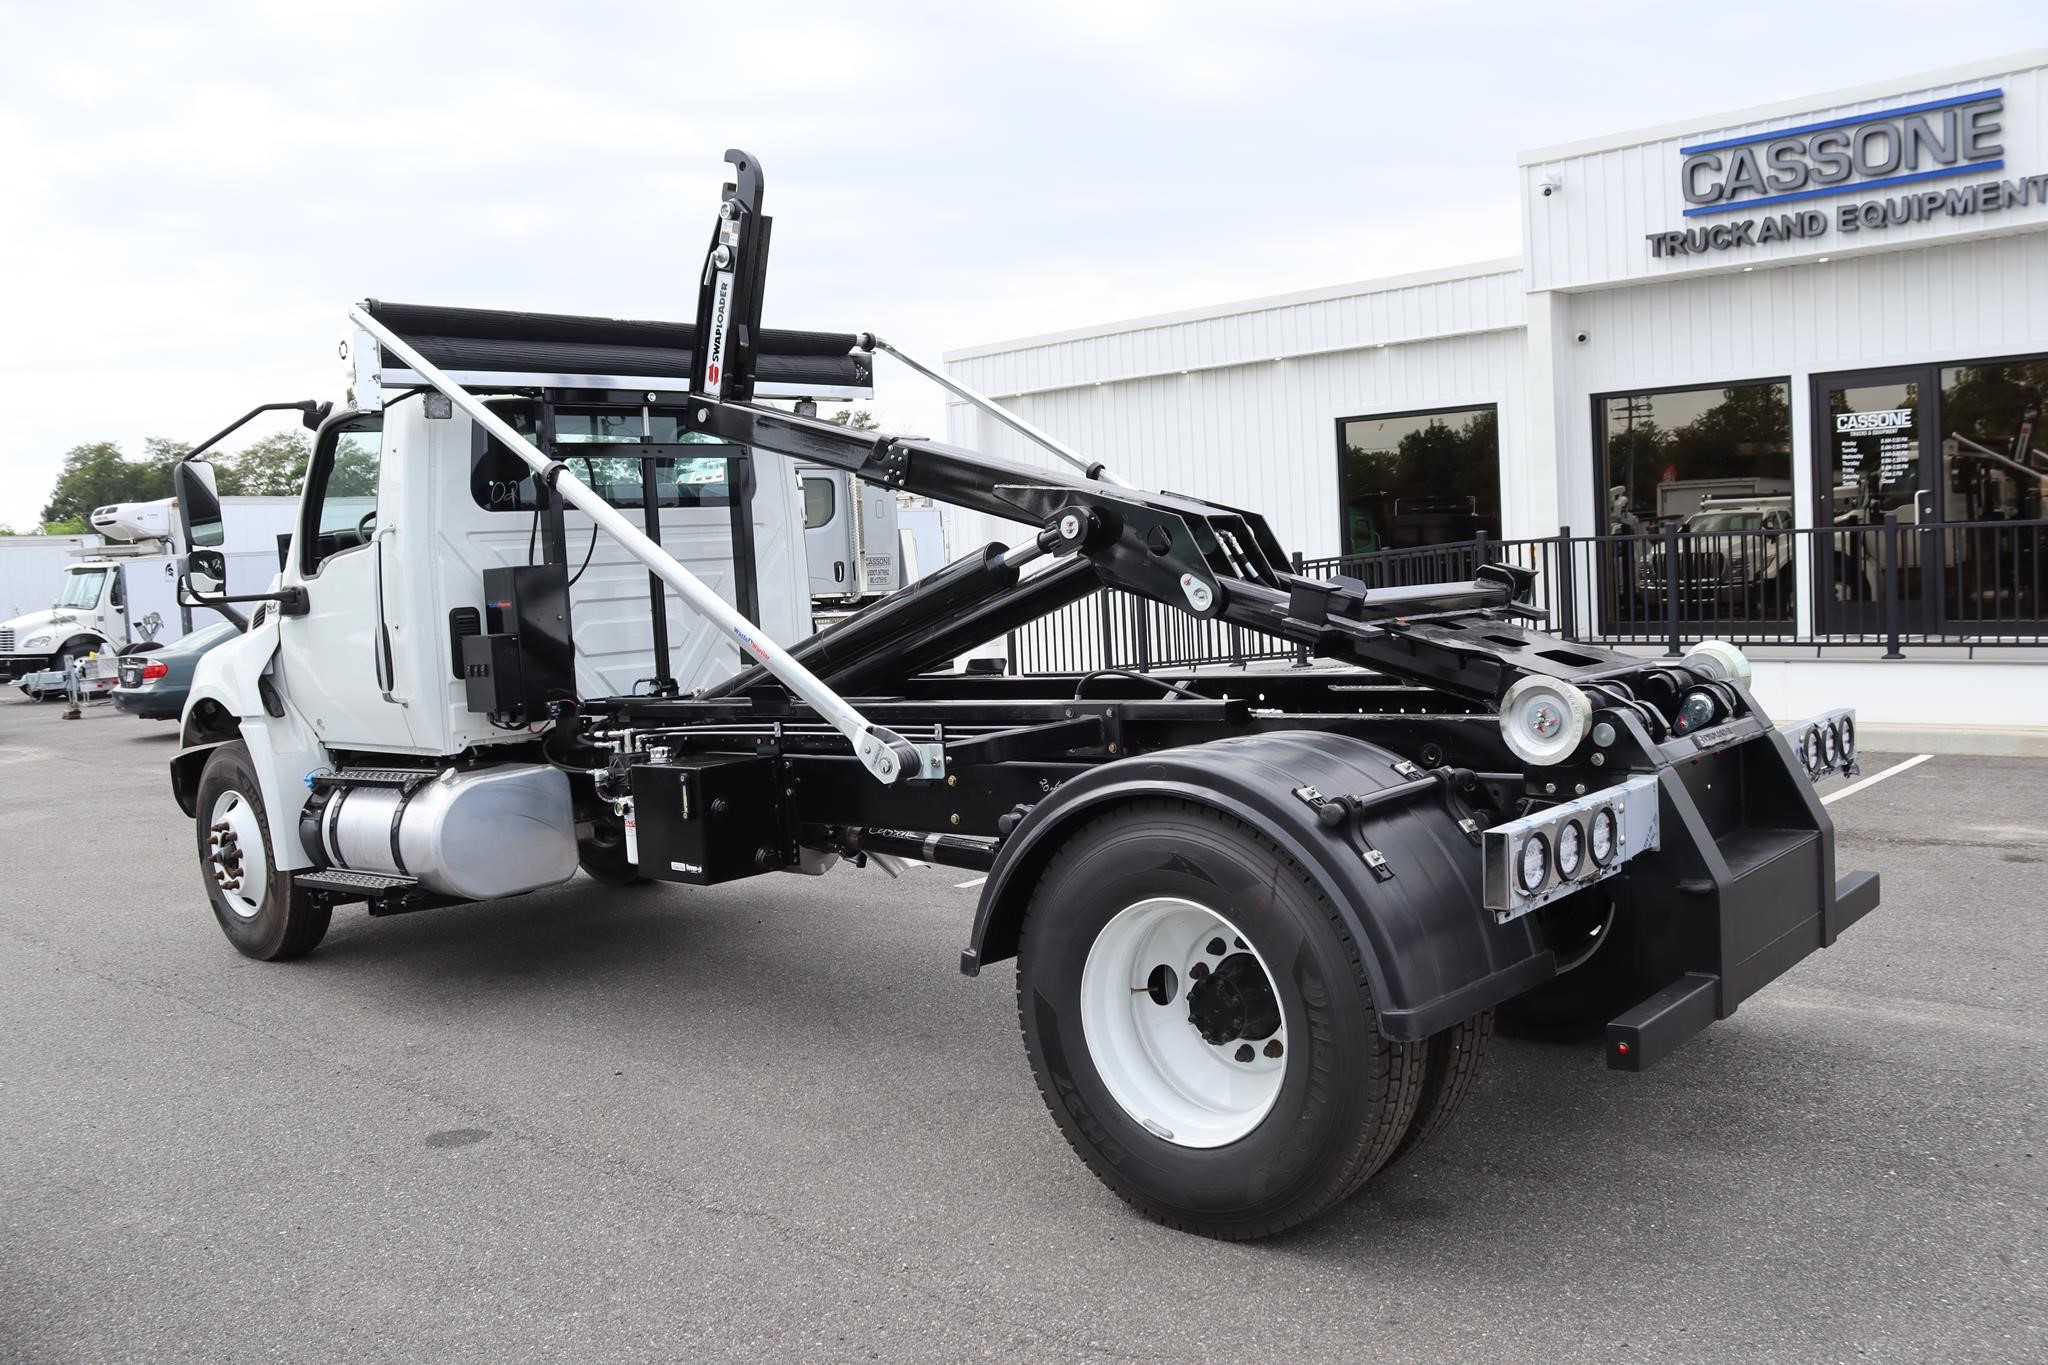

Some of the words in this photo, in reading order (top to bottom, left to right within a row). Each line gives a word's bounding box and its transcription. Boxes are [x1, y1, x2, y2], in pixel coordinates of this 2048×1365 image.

[1681, 102, 2003, 204] CASSONE
[1646, 219, 1757, 258] TRUCK
[1757, 209, 1828, 244] AND
[1837, 172, 2048, 233] EQUIPMENT
[712, 281, 729, 363] SWAPLOADER
[1837, 411, 1911, 430] CASSONE
